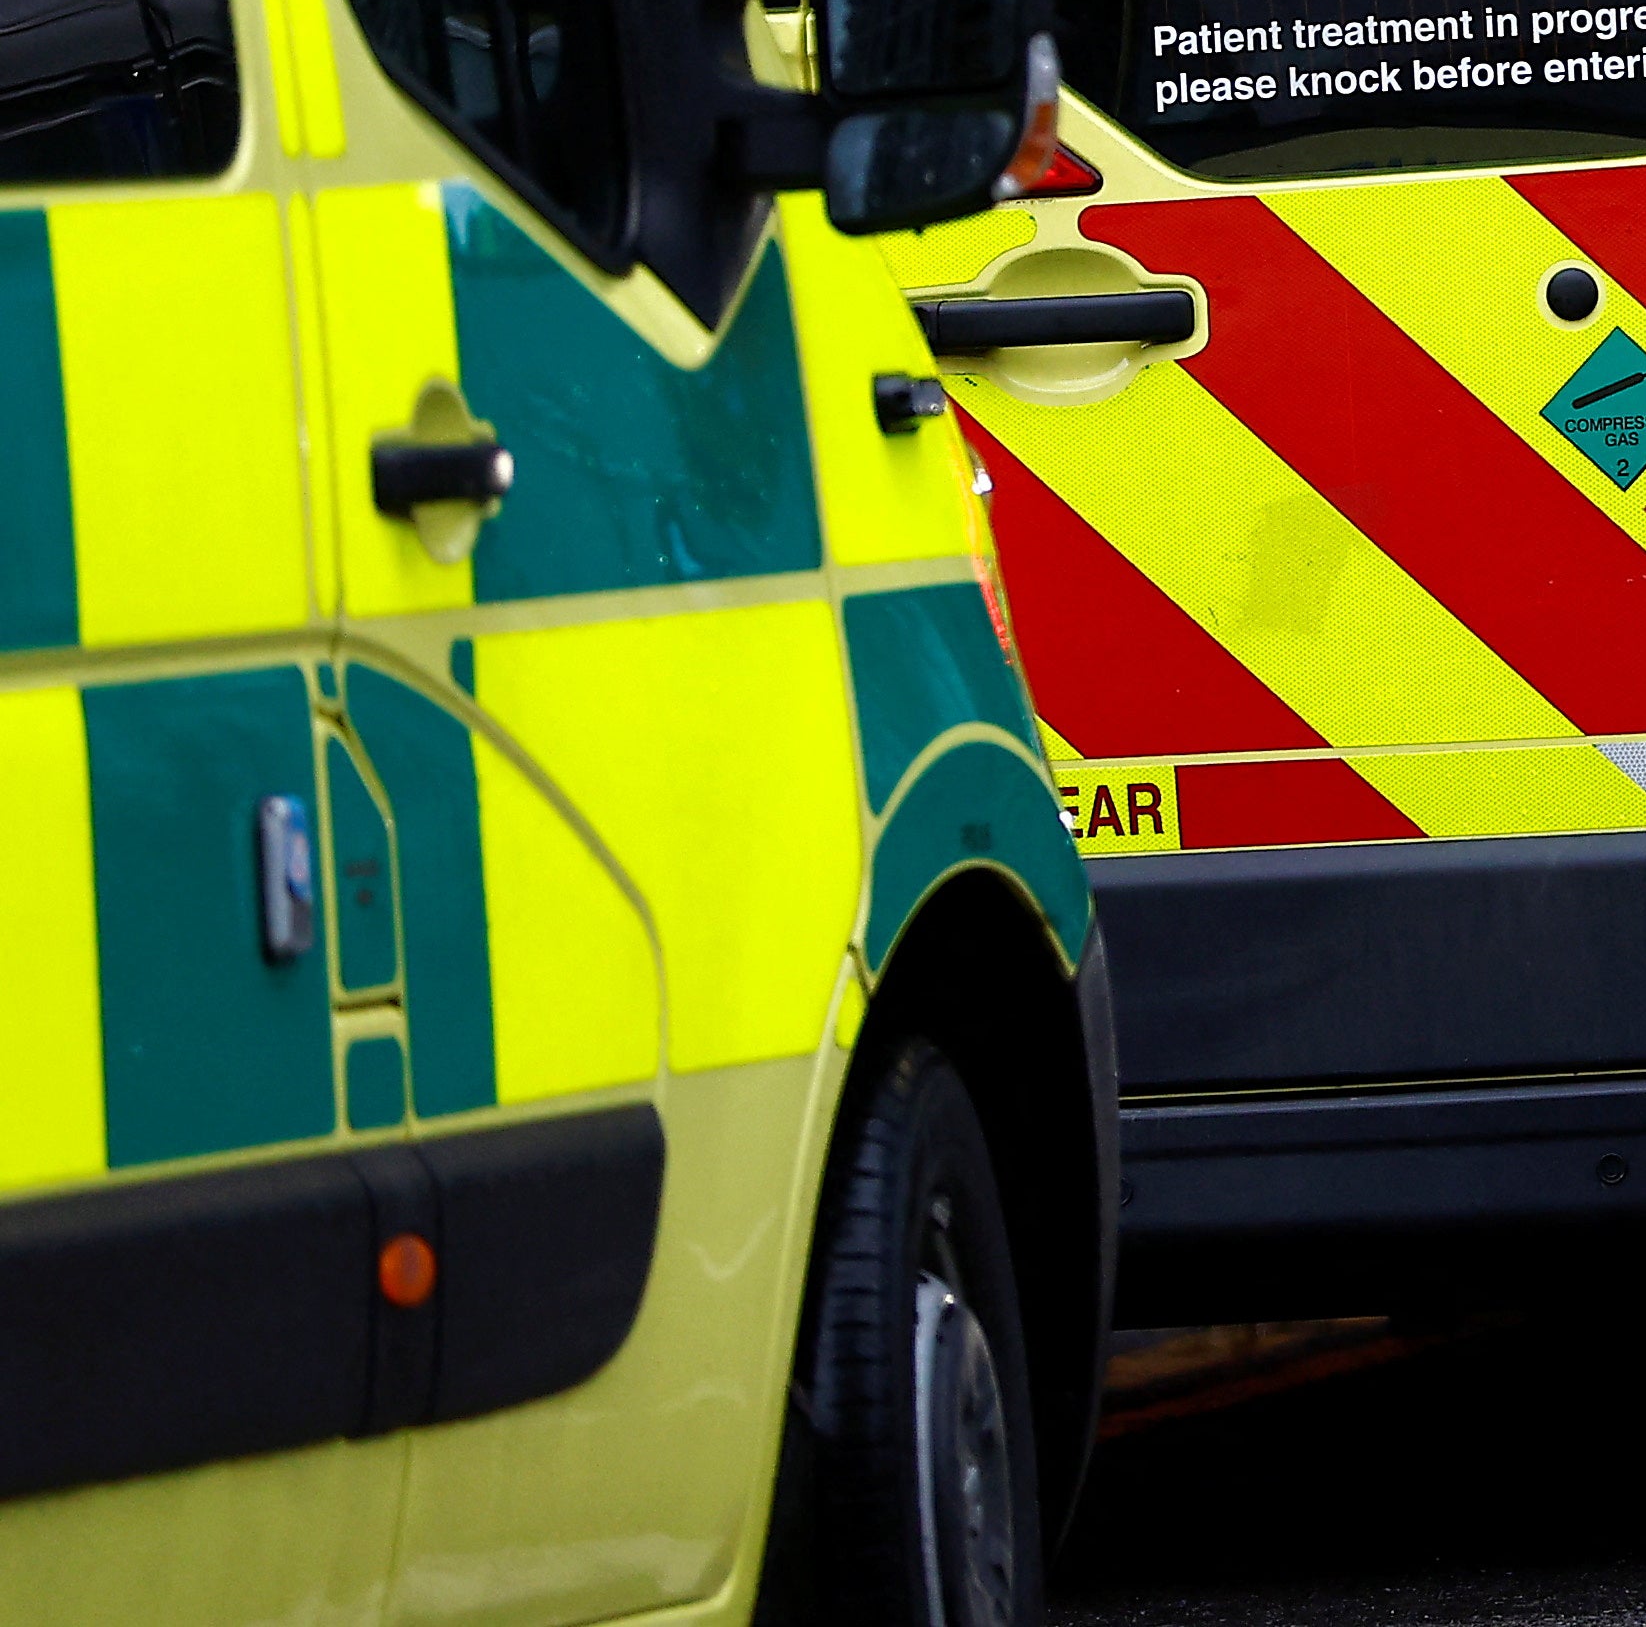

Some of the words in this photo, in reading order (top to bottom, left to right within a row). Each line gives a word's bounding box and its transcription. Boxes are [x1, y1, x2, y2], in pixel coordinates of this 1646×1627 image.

[1154, 21, 1283, 57] Patient
[1292, 10, 1474, 49] treatment
[1484, 7, 1519, 38] in
[1156, 72, 1277, 113] please
[1289, 62, 1402, 97] knock
[1413, 56, 1533, 91] before
[1604, 432, 1639, 447] GAS
[1616, 458, 1630, 478] 2
